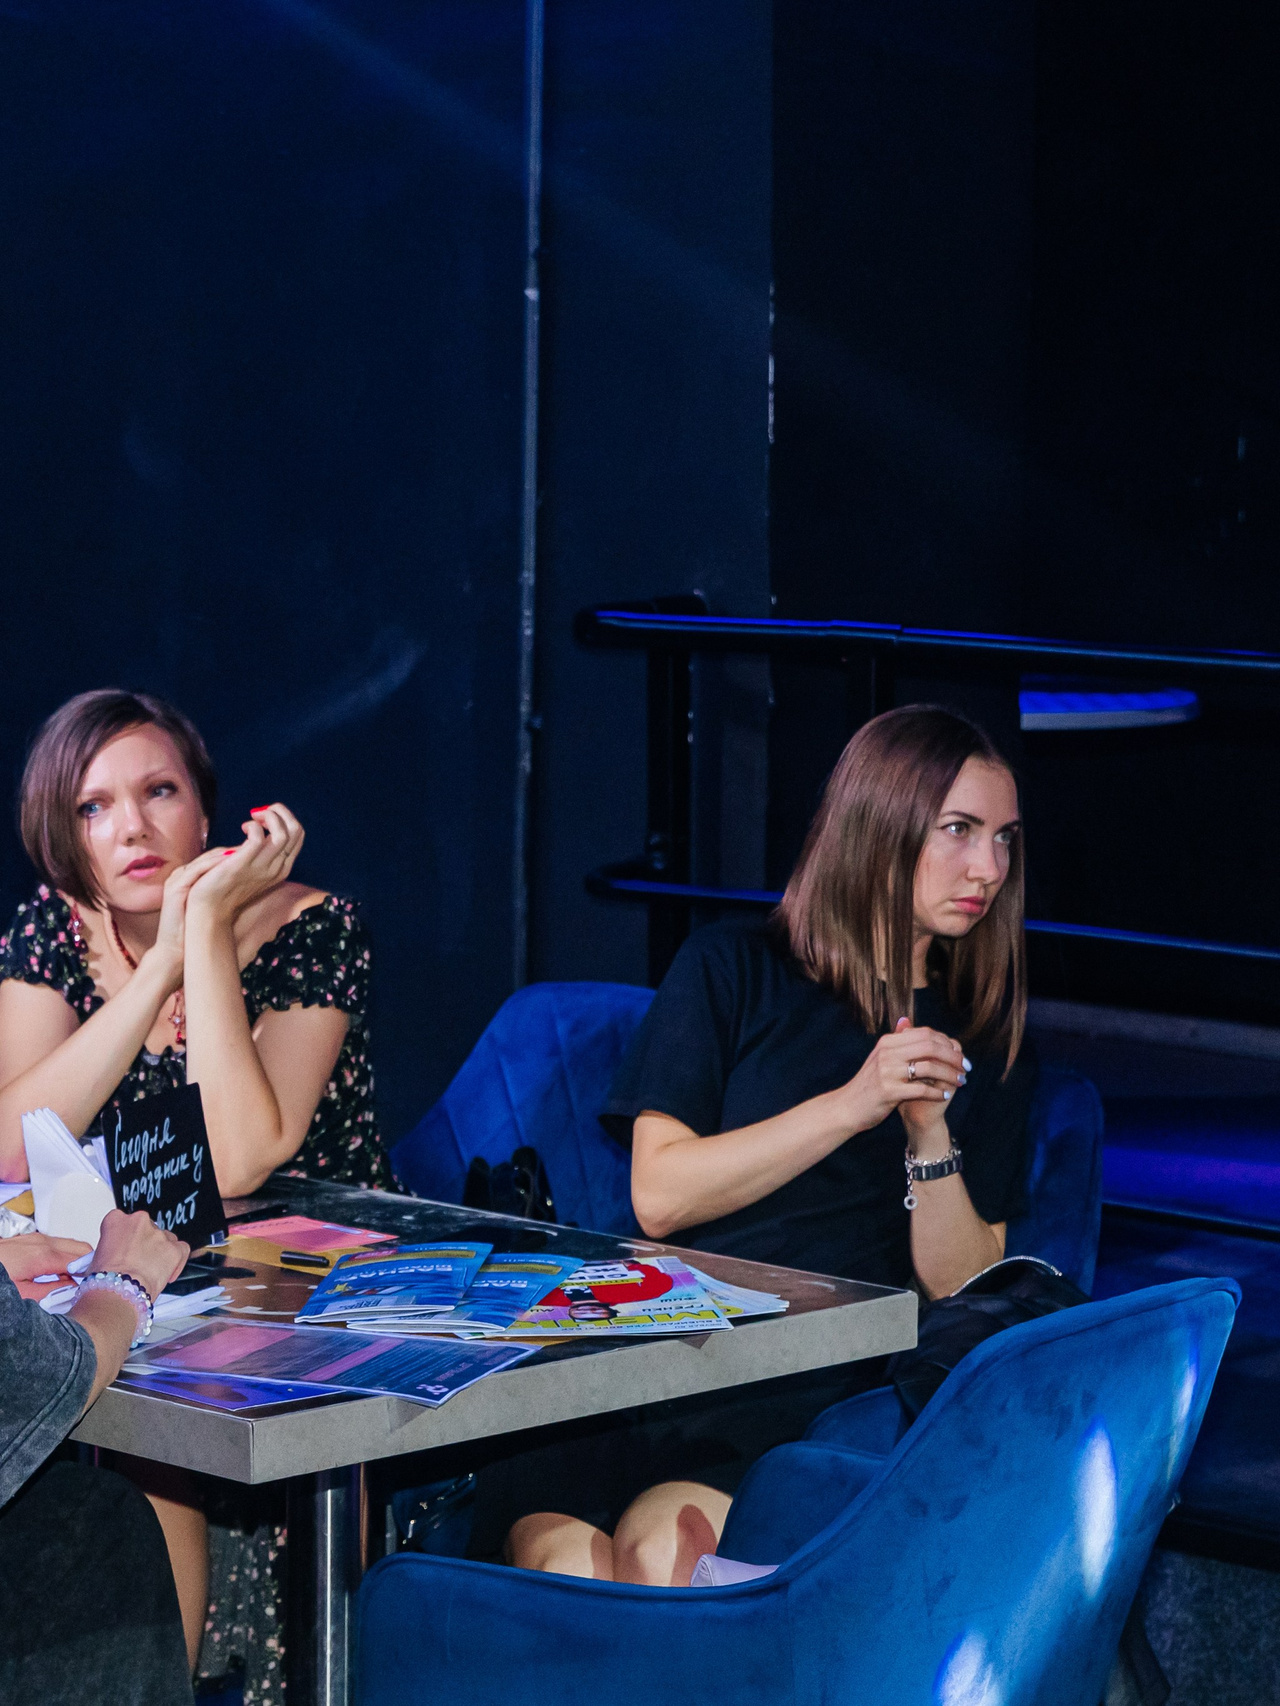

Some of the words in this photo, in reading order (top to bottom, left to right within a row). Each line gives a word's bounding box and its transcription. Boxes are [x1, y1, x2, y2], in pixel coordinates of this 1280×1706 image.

[114, 1109, 176, 1173] Сегодня
[122, 1152, 190, 1212] праздник
[193, 1143, 203, 1183] у
[642, 1304, 704, 1312] ГРЕНКИ
